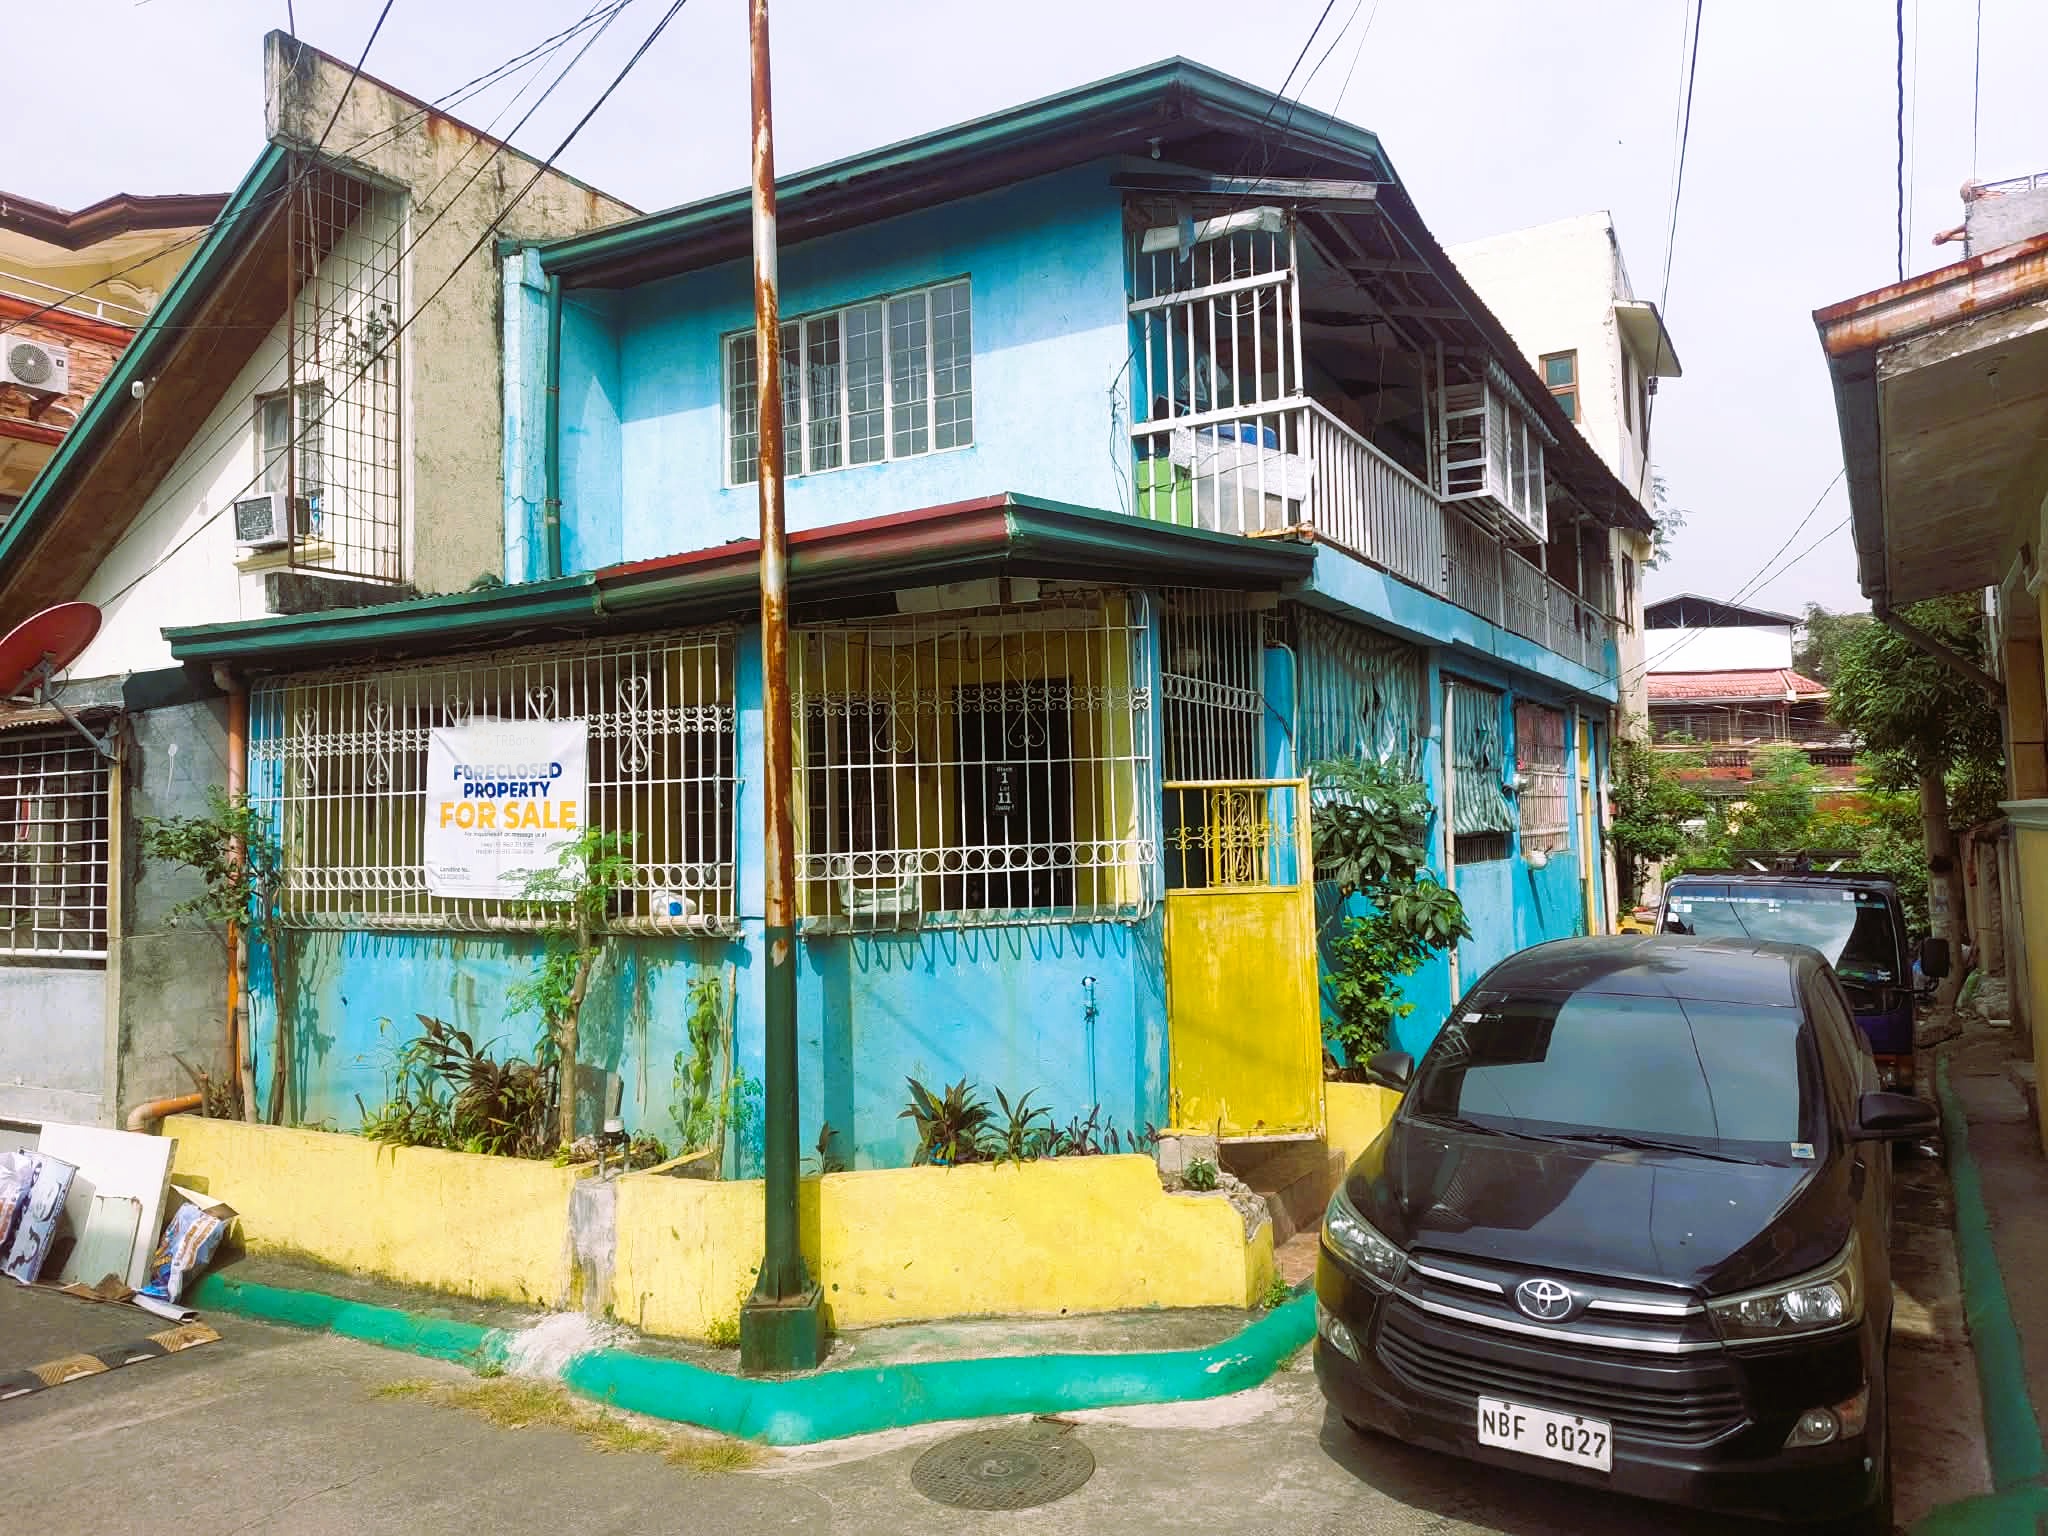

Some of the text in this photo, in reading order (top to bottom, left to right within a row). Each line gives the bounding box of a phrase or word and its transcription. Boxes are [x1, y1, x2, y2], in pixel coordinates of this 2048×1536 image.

[454, 762, 562, 780] FORECLOSED
[464, 781, 551, 798] PROPERTY
[440, 801, 576, 829] FOR SALE
[1483, 1409, 1606, 1458] NBF 8027
